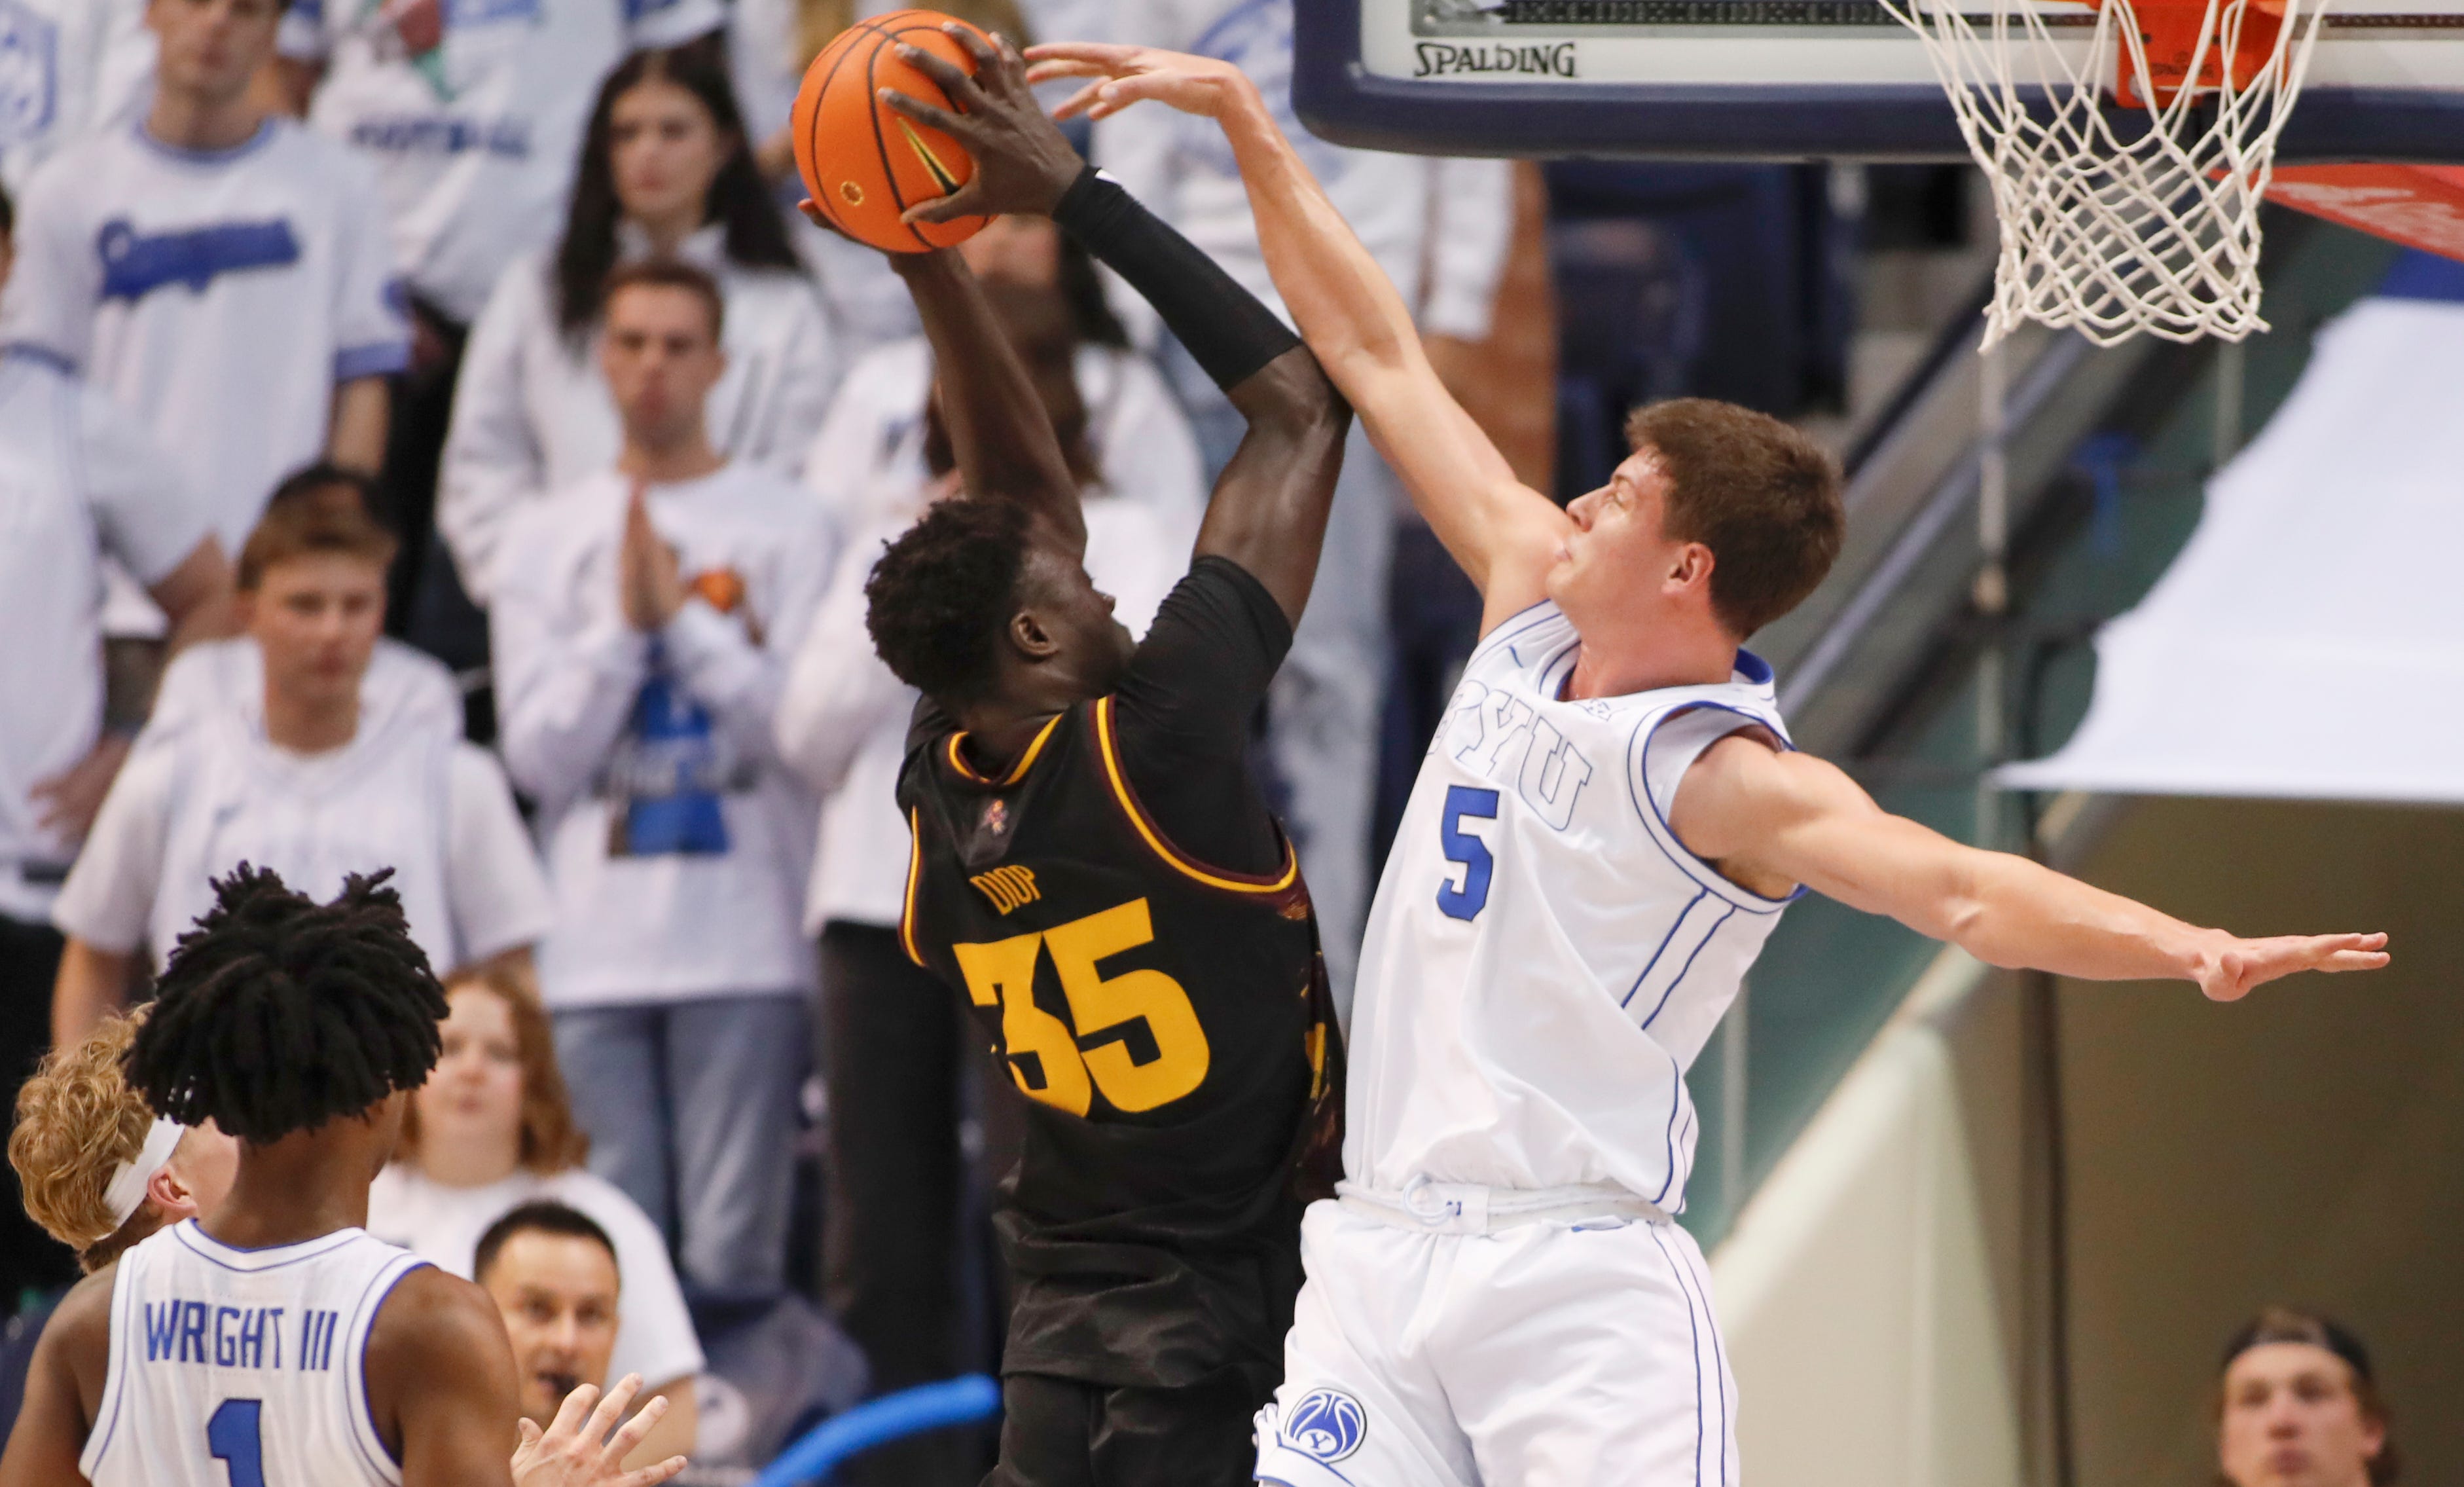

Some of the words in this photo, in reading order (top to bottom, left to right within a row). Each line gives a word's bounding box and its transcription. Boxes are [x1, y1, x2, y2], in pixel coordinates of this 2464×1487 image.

[1414, 41, 1576, 77] SPALDING
[969, 864, 1042, 916] DIOP
[1436, 784, 1500, 923] 5
[951, 896, 1211, 1118] 35
[144, 1299, 284, 1369] WRGHT
[299, 1310, 338, 1370] III
[206, 1397, 267, 1487] 1
